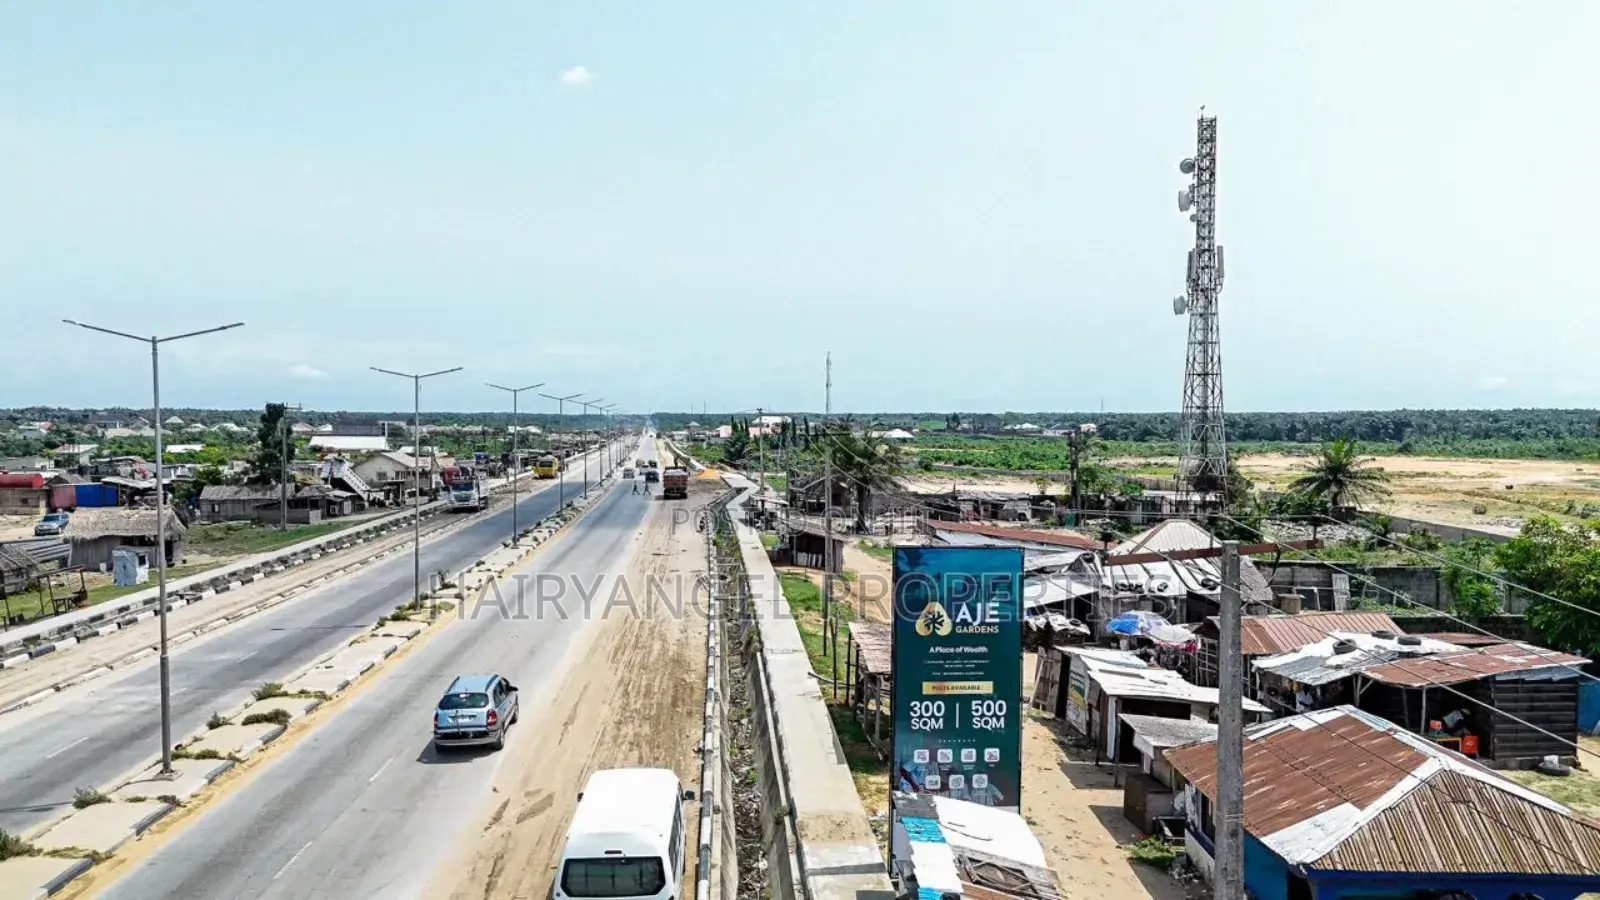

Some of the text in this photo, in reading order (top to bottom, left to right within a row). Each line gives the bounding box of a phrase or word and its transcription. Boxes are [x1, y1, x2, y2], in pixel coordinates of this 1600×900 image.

[955, 596, 1000, 626] AJÉ
[955, 625, 1000, 634] GARDENS
[909, 700, 945, 717] 300
[971, 700, 1007, 716] 500
[911, 718, 944, 731] SQM
[972, 717, 1005, 730] SQM
